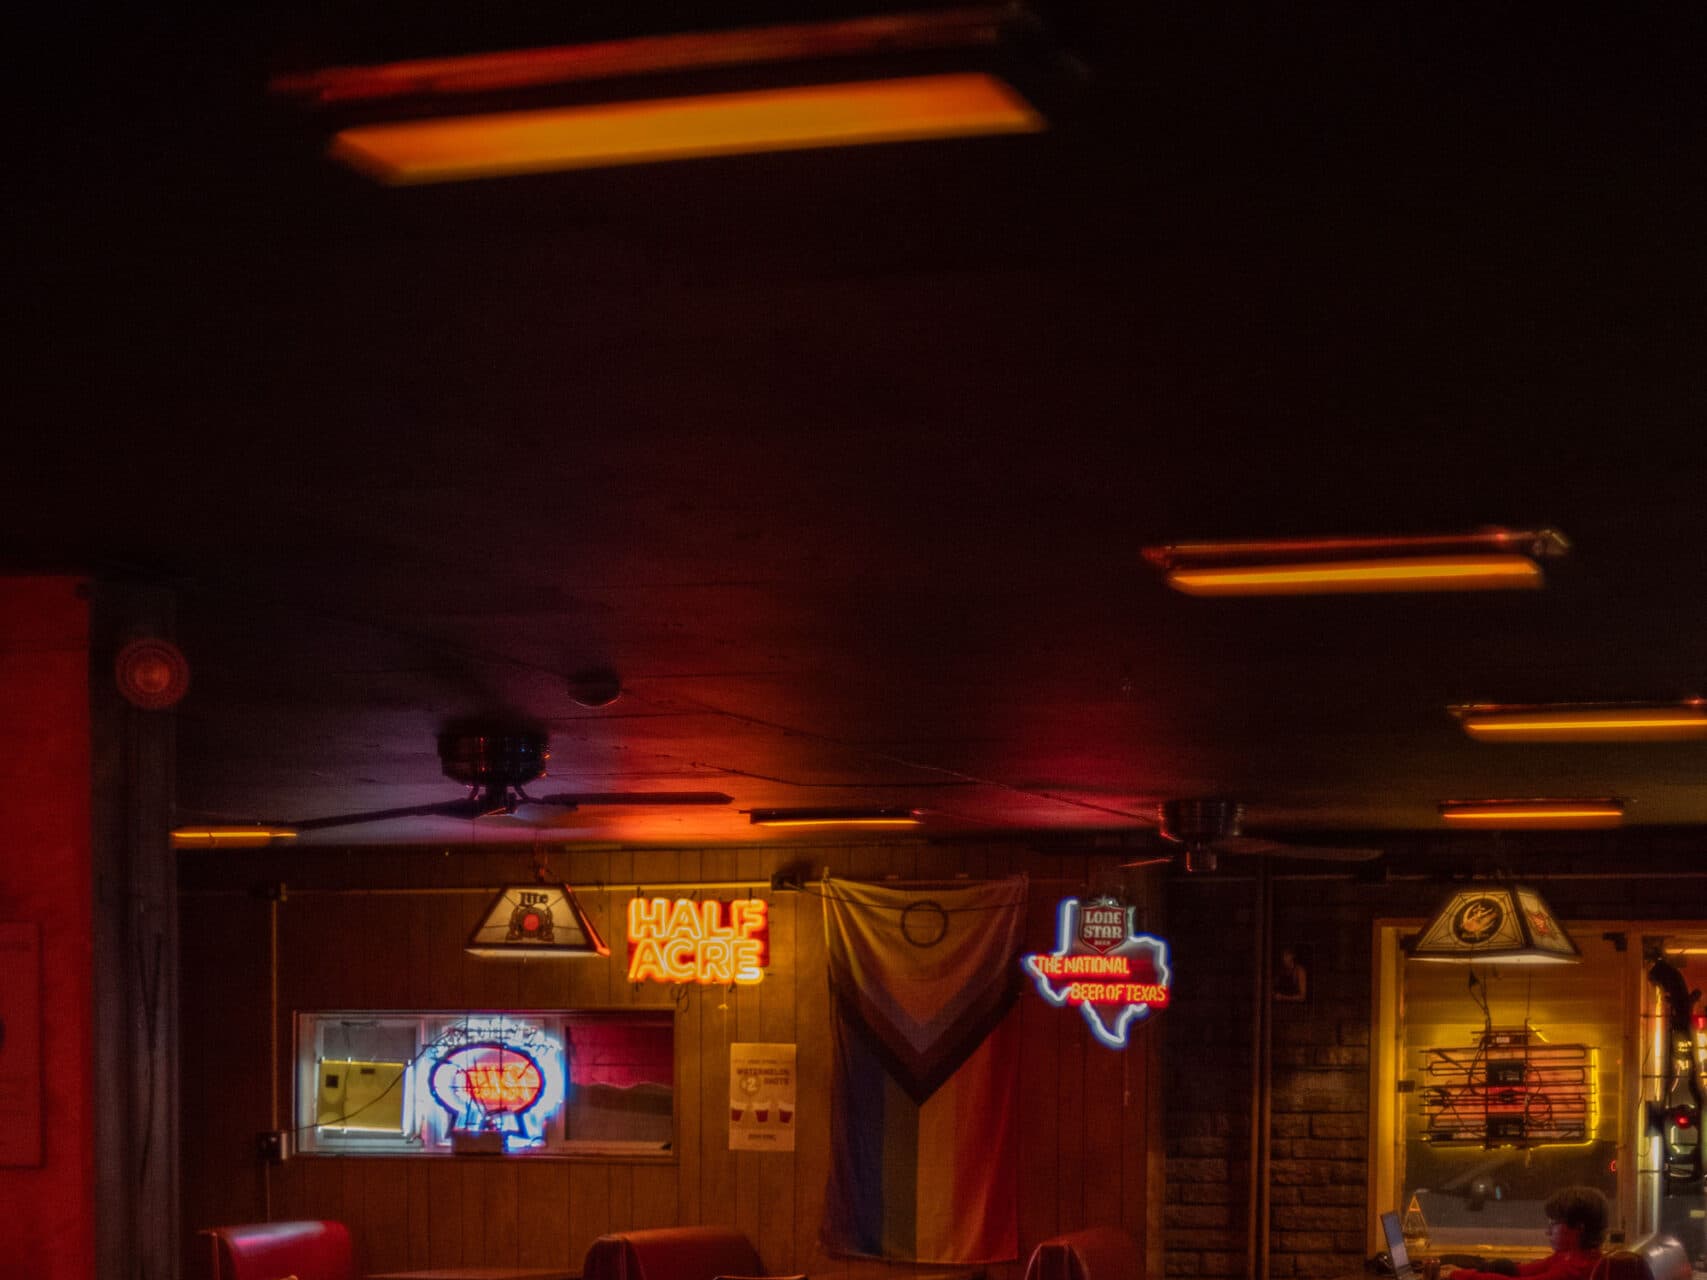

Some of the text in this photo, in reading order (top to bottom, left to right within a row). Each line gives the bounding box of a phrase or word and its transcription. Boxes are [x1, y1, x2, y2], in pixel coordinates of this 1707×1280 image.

[629, 898, 766, 940] HALF
[1085, 911, 1122, 924] LONE
[1083, 926, 1123, 939] STAR
[628, 939, 765, 980] ACRE
[1037, 956, 1130, 974] THE NATIONAL
[1070, 982, 1167, 1002] BEER OF TEXAS
